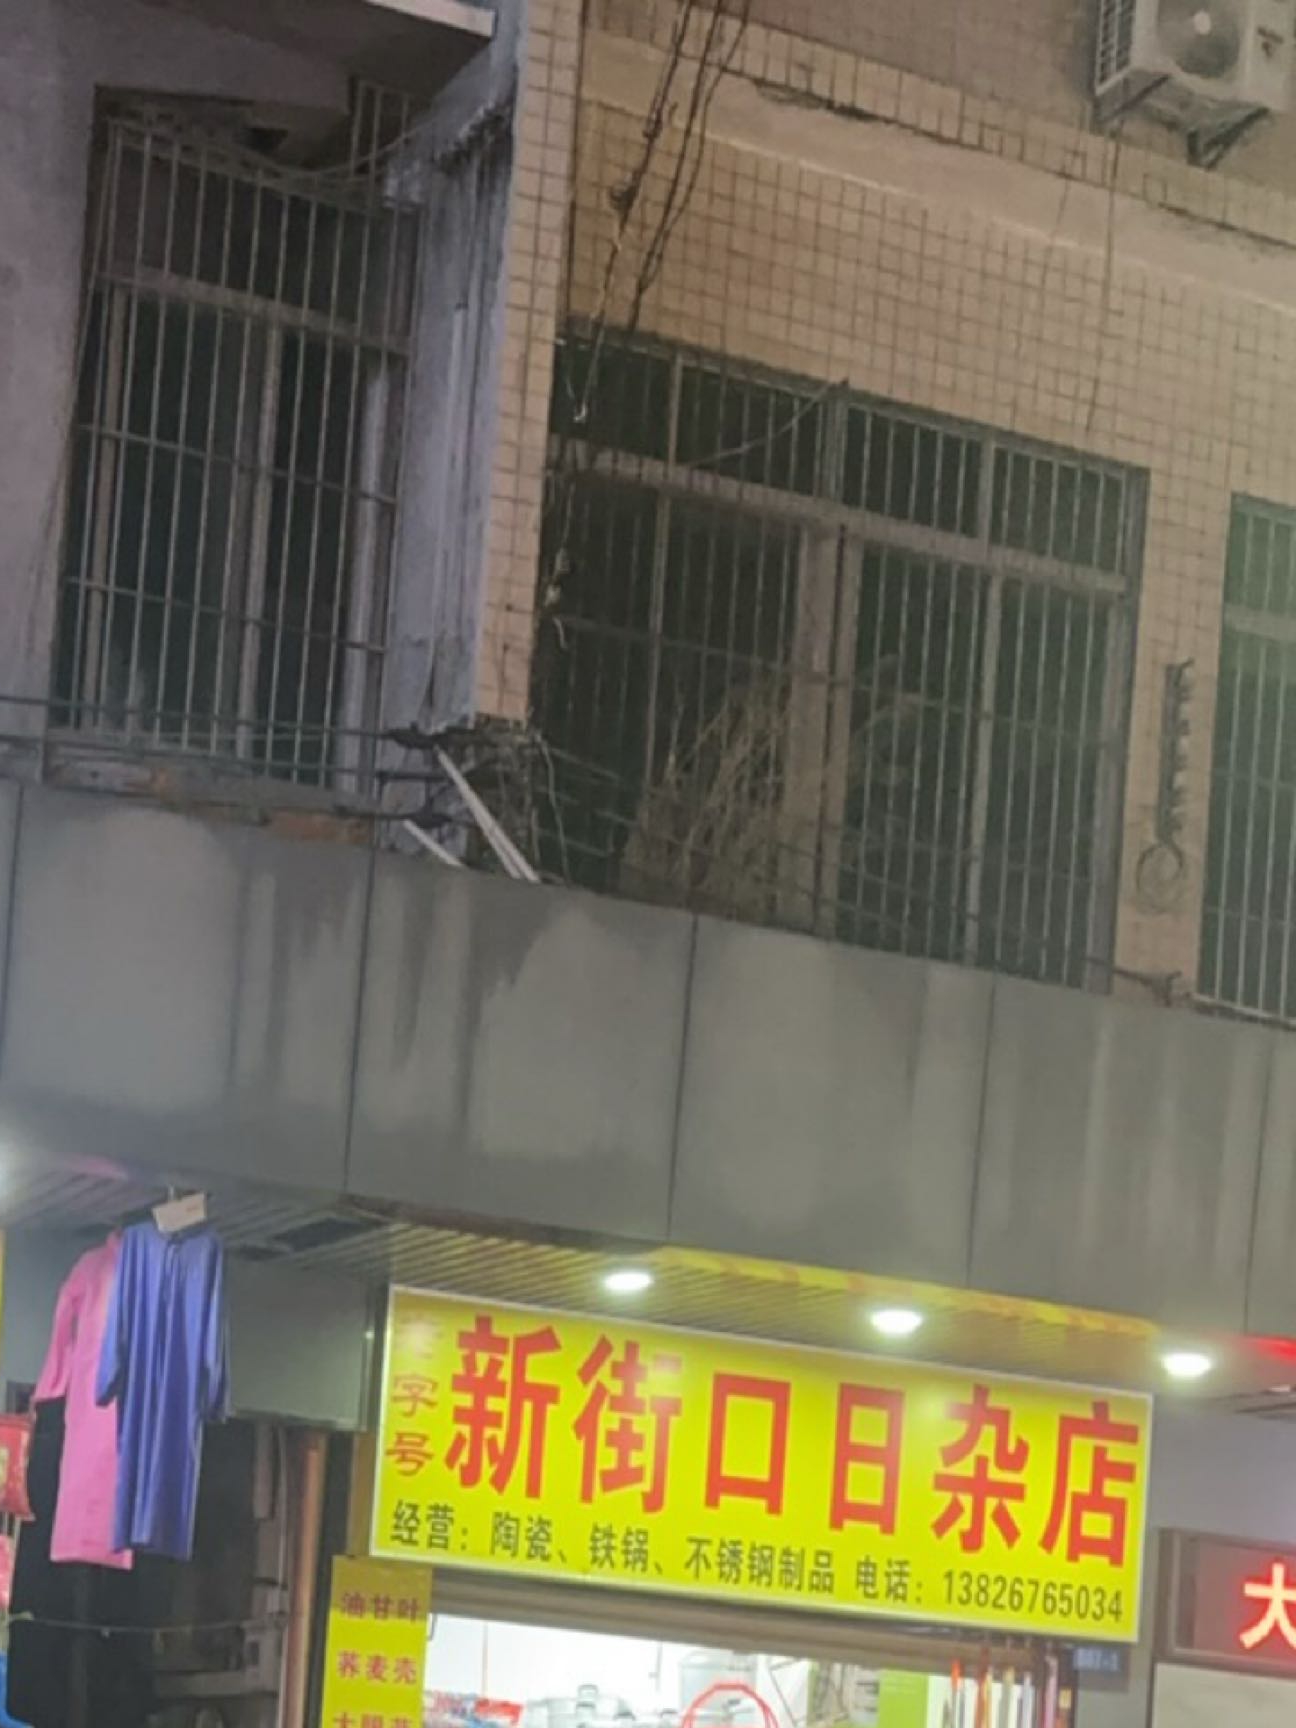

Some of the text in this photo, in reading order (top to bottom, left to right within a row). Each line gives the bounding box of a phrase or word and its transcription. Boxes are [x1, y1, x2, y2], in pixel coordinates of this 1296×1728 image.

[444, 1314, 1140, 1569] 新街口日杂店
